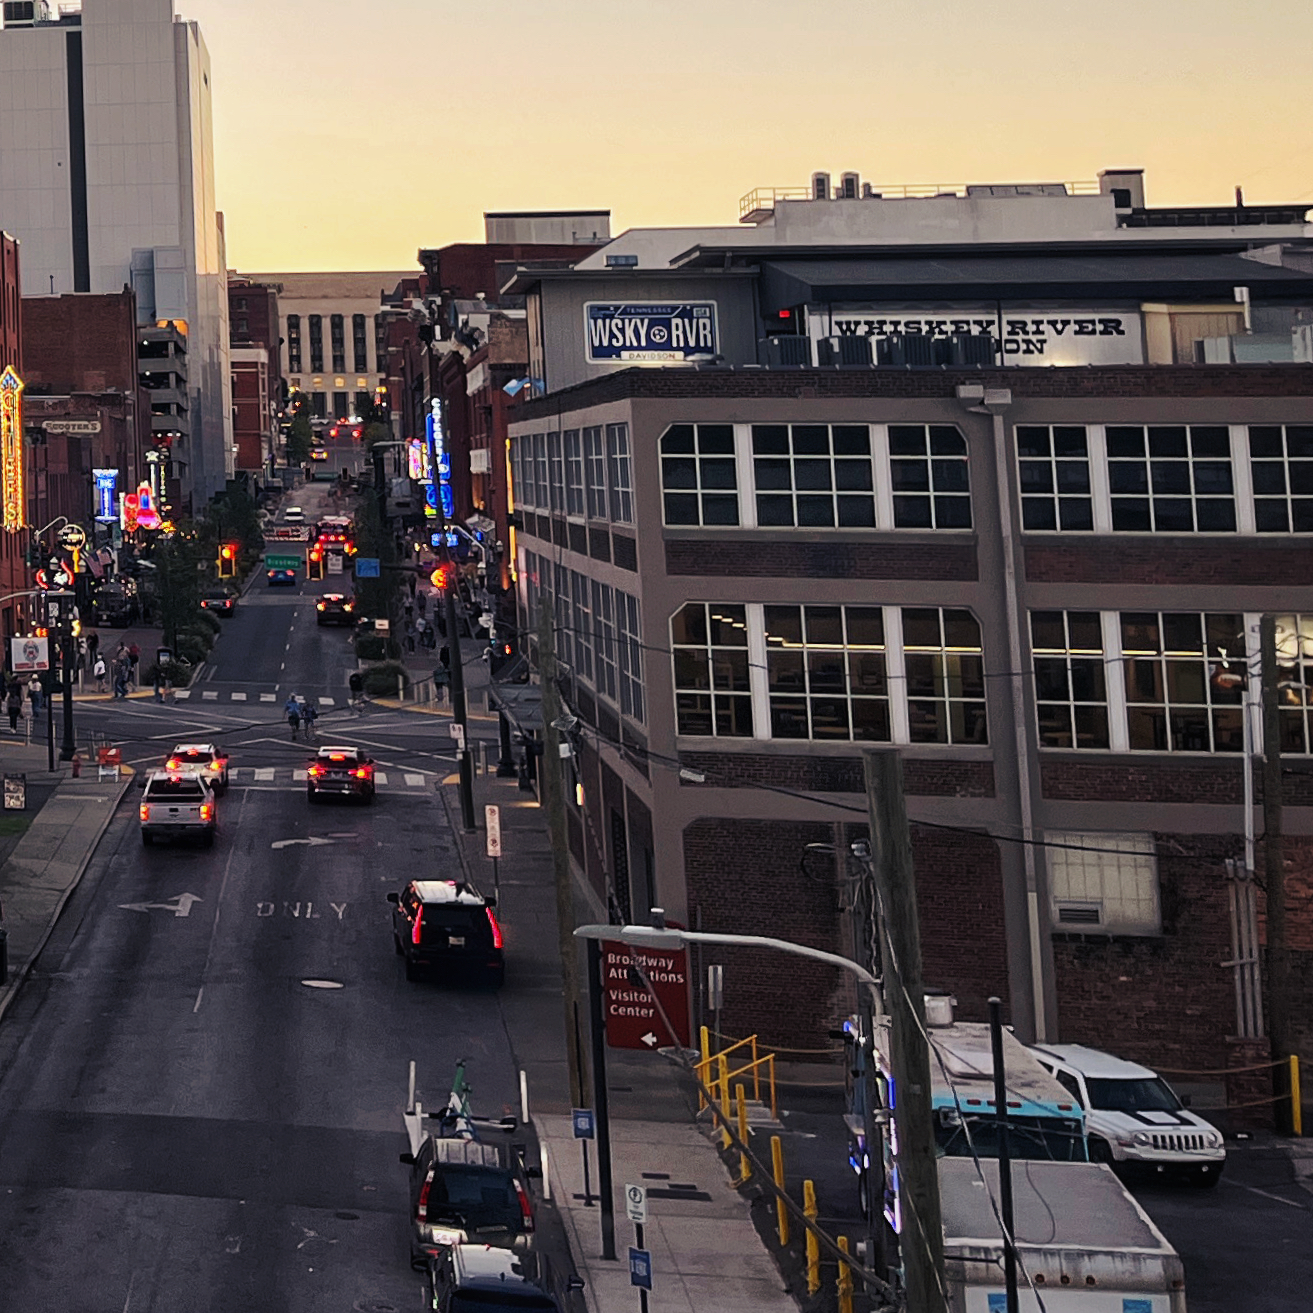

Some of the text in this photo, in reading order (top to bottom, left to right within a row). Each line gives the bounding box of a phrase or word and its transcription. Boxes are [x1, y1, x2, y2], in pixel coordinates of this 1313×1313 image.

[590, 318, 712, 347] WSKY RVR
[834, 318, 1126, 336] WHISKEY RIVER
[256, 901, 348, 920] ONLY
[609, 989, 652, 1003] Visitor
[610, 1004, 655, 1018] Center
